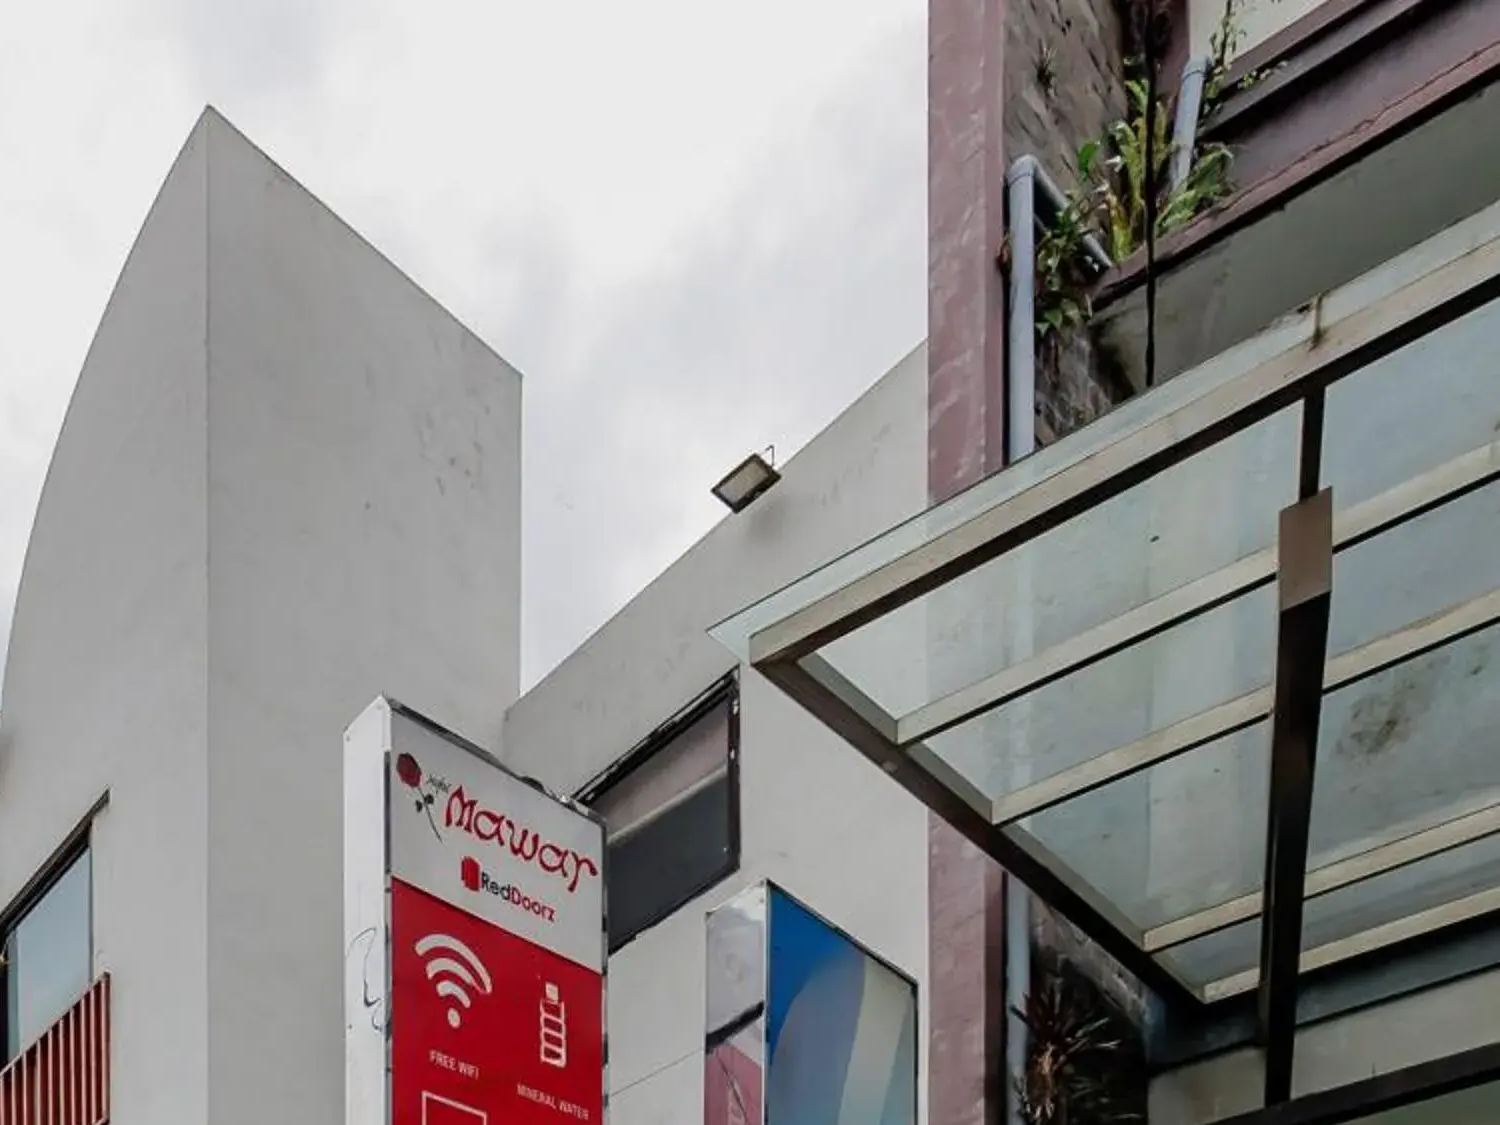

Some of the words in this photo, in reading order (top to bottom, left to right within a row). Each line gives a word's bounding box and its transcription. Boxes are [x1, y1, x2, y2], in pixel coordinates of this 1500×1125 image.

[445, 785, 598, 893] Mawar
[480, 871, 556, 923] RedDoorz
[429, 1050, 457, 1072] FREE
[457, 1060, 480, 1081] WIFI
[516, 1083, 557, 1109] MINERAL
[558, 1101, 590, 1121] WATER
